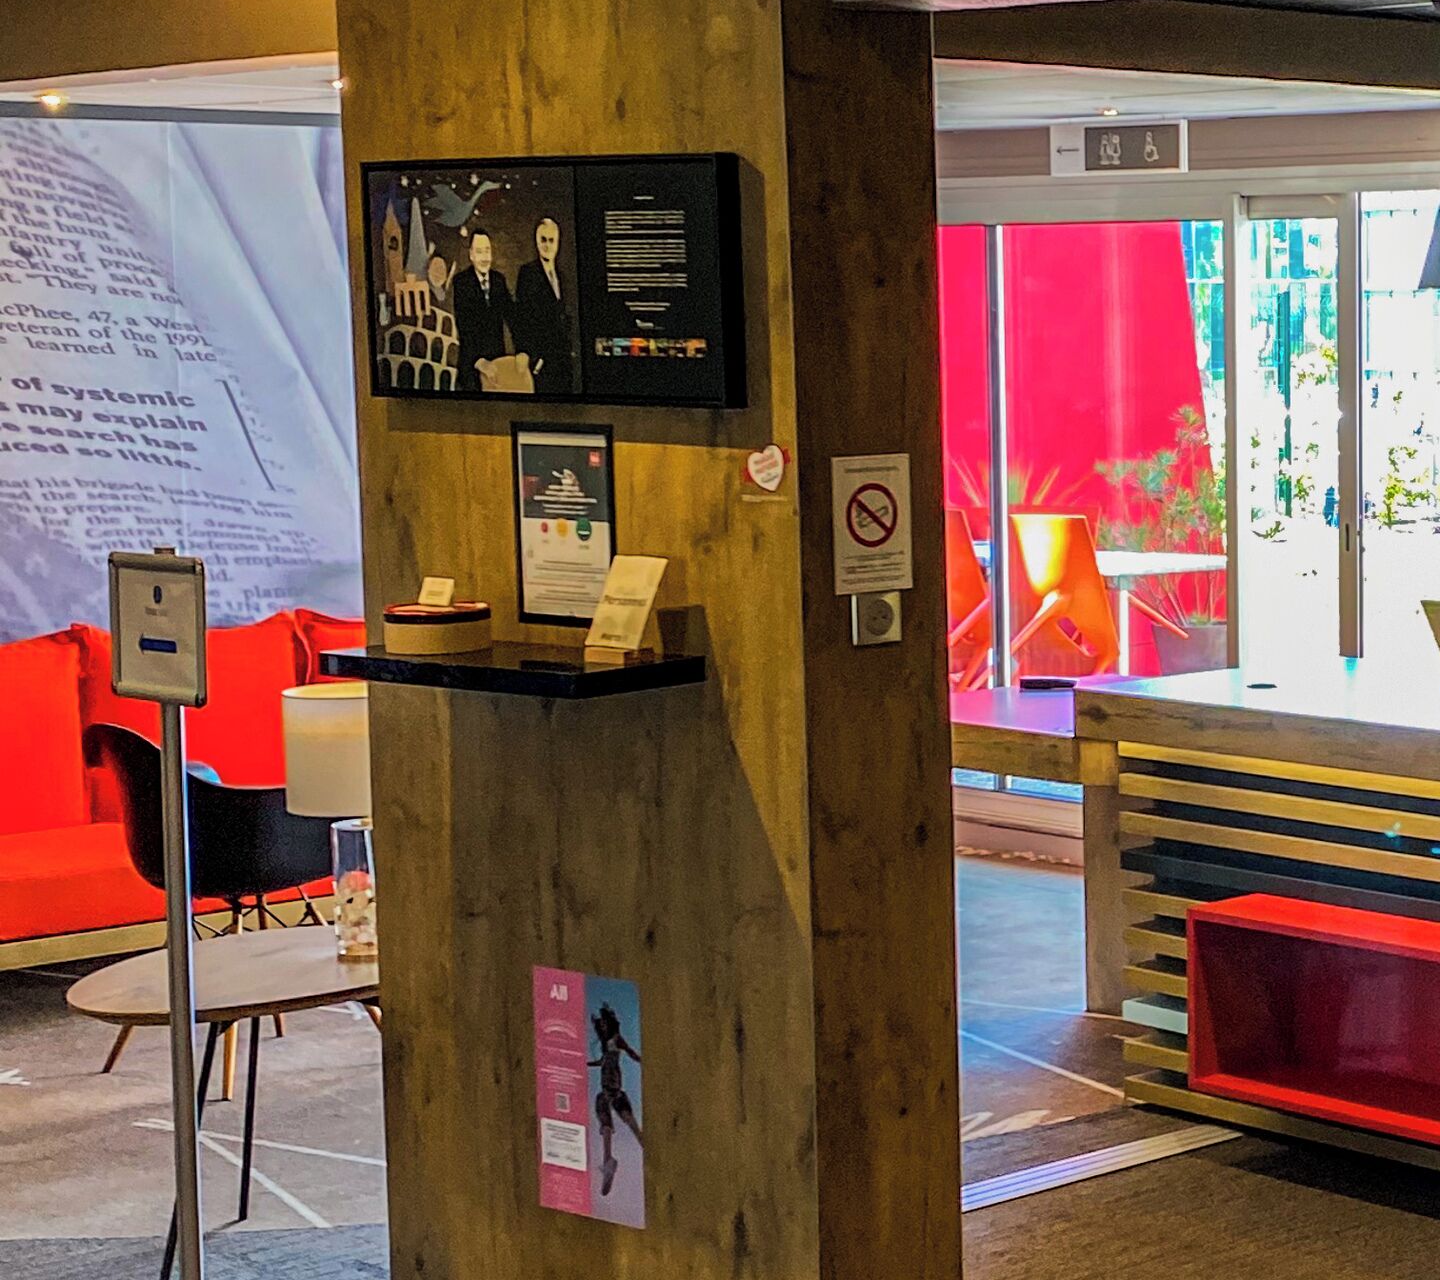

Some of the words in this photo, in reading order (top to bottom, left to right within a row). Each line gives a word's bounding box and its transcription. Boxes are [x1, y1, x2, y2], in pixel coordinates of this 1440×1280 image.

[11, 213, 51, 230] the
[54, 219, 119, 242] hunt.
[62, 251, 87, 265] of
[109, 271, 158, 289] said
[106, 285, 145, 300] are
[0, 302, 80, 323] cPhee,
[88, 309, 120, 326] 47,
[125, 315, 140, 327] a
[144, 314, 205, 334] West
[88, 325, 113, 340] of
[120, 327, 158, 345] the
[165, 331, 215, 348] 1991
[24, 335, 117, 356] learned
[134, 343, 160, 360] in
[173, 347, 219, 363] late
[11, 376, 44, 392] of
[50, 383, 196, 408] systemic
[16, 401, 83, 423] may
[92, 410, 208, 433] explain
[27, 424, 136, 445] search
[140, 432, 198, 453] has
[75, 446, 112, 459] so
[117, 447, 203, 472] little.
[35, 476, 71, 490] his
[73, 476, 155, 494] brigade
[41, 491, 77, 502] the
[34, 503, 58, 515] to
[85, 526, 165, 539] Central
